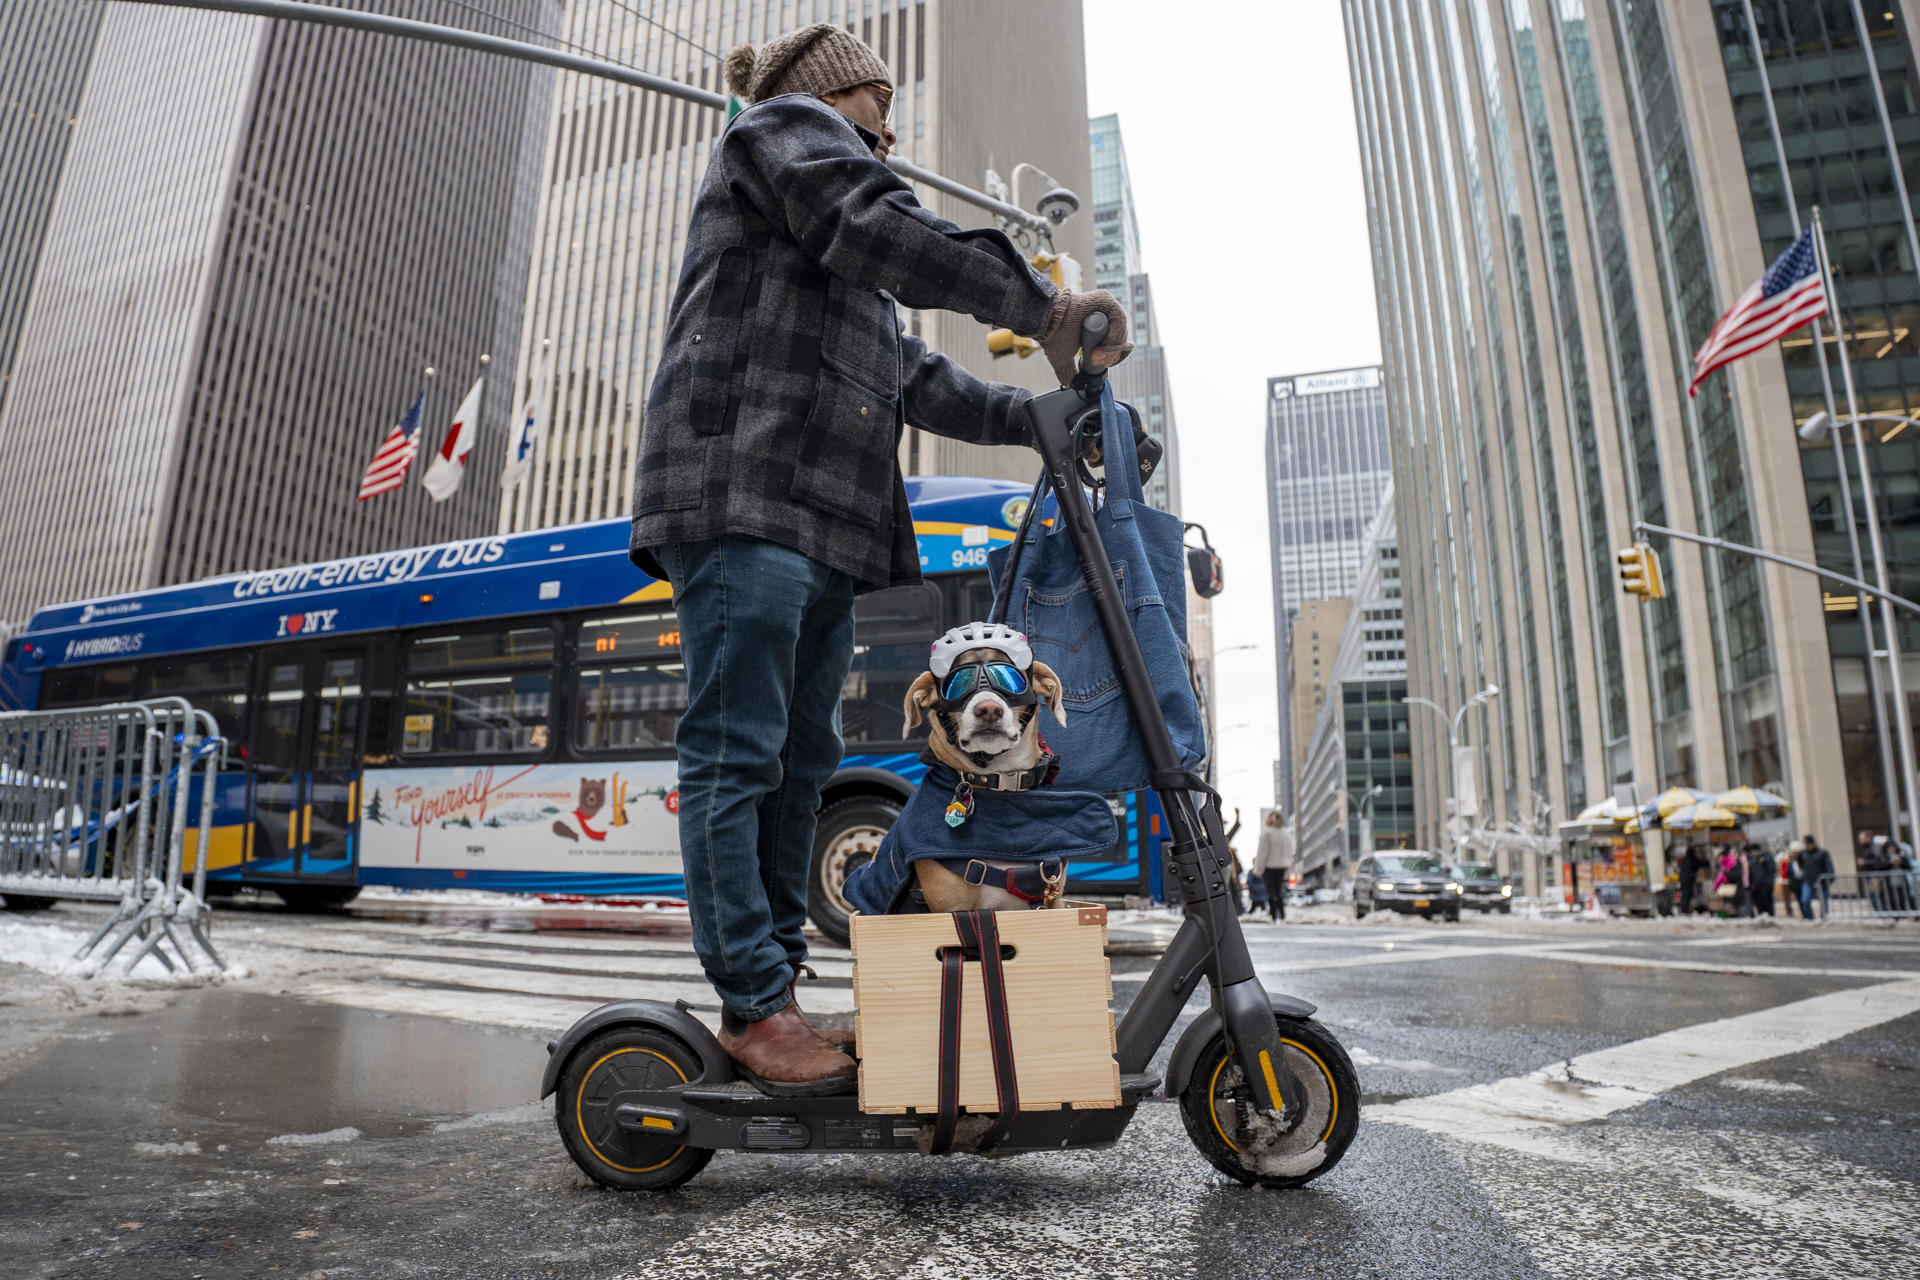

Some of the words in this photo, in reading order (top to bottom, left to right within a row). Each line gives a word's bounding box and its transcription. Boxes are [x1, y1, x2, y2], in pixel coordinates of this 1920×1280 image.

[233, 549, 436, 598] clean-energy
[437, 539, 507, 570] bus
[952, 546, 996, 567] 946
[277, 615, 288, 636] I
[302, 609, 338, 633] NY
